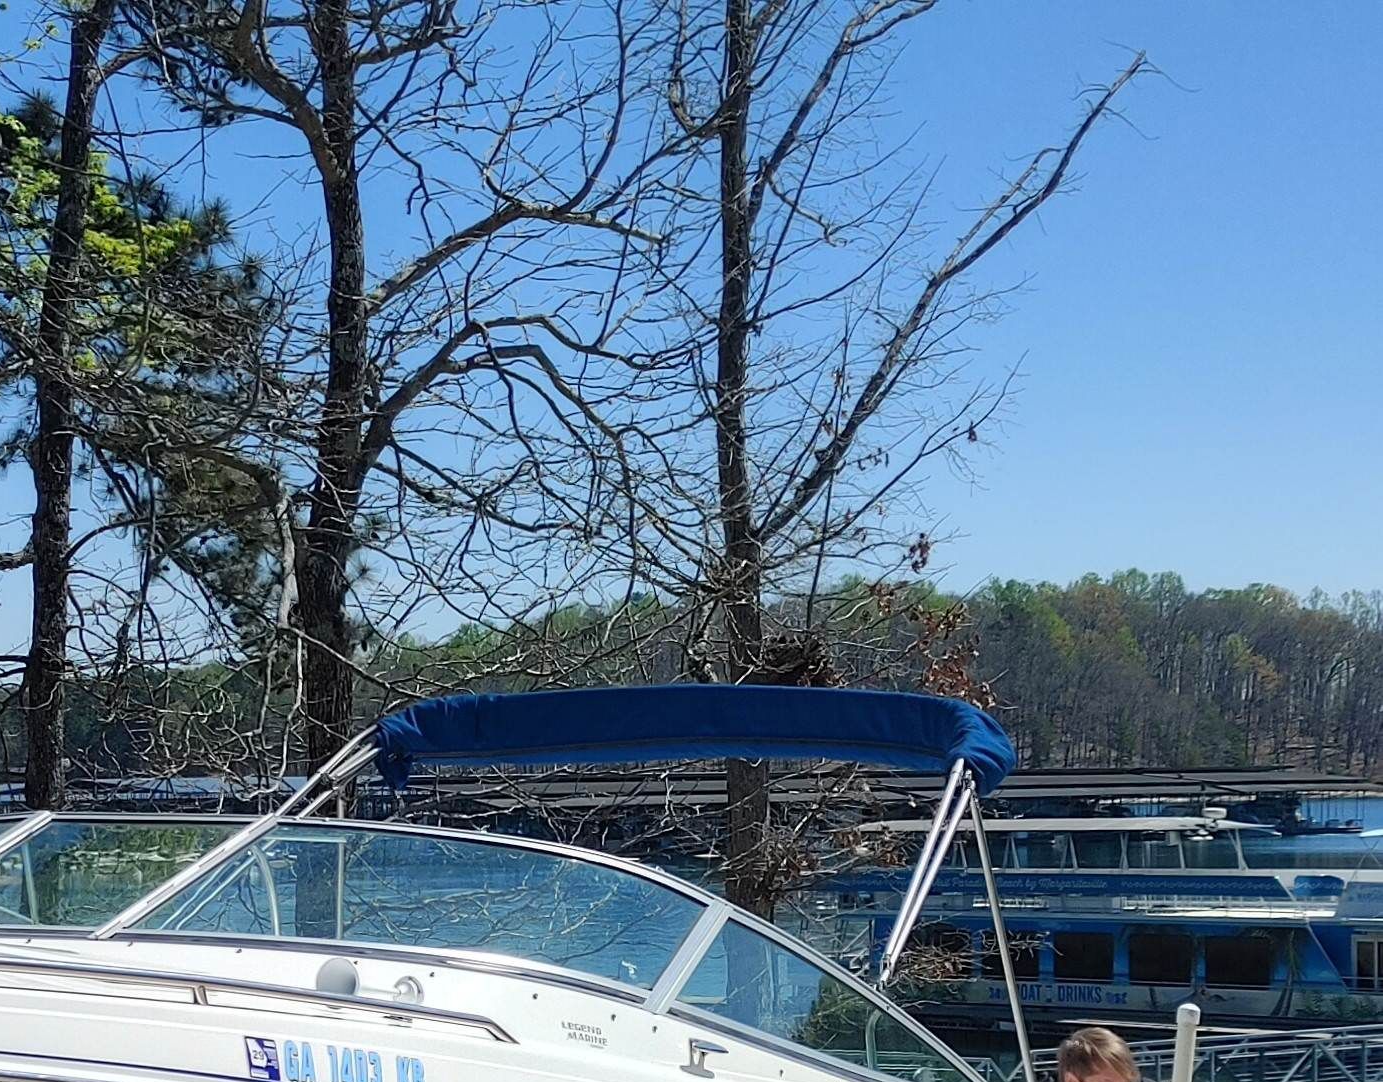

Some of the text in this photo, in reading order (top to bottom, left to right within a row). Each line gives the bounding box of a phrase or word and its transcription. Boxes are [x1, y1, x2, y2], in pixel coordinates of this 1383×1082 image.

[1025, 877, 1037, 890] by
[1016, 983, 1043, 1001] OAT
[1057, 984, 1102, 1004] DRINKS
[561, 1020, 602, 1035] LEGEND
[567, 1031, 608, 1046] MARINE
